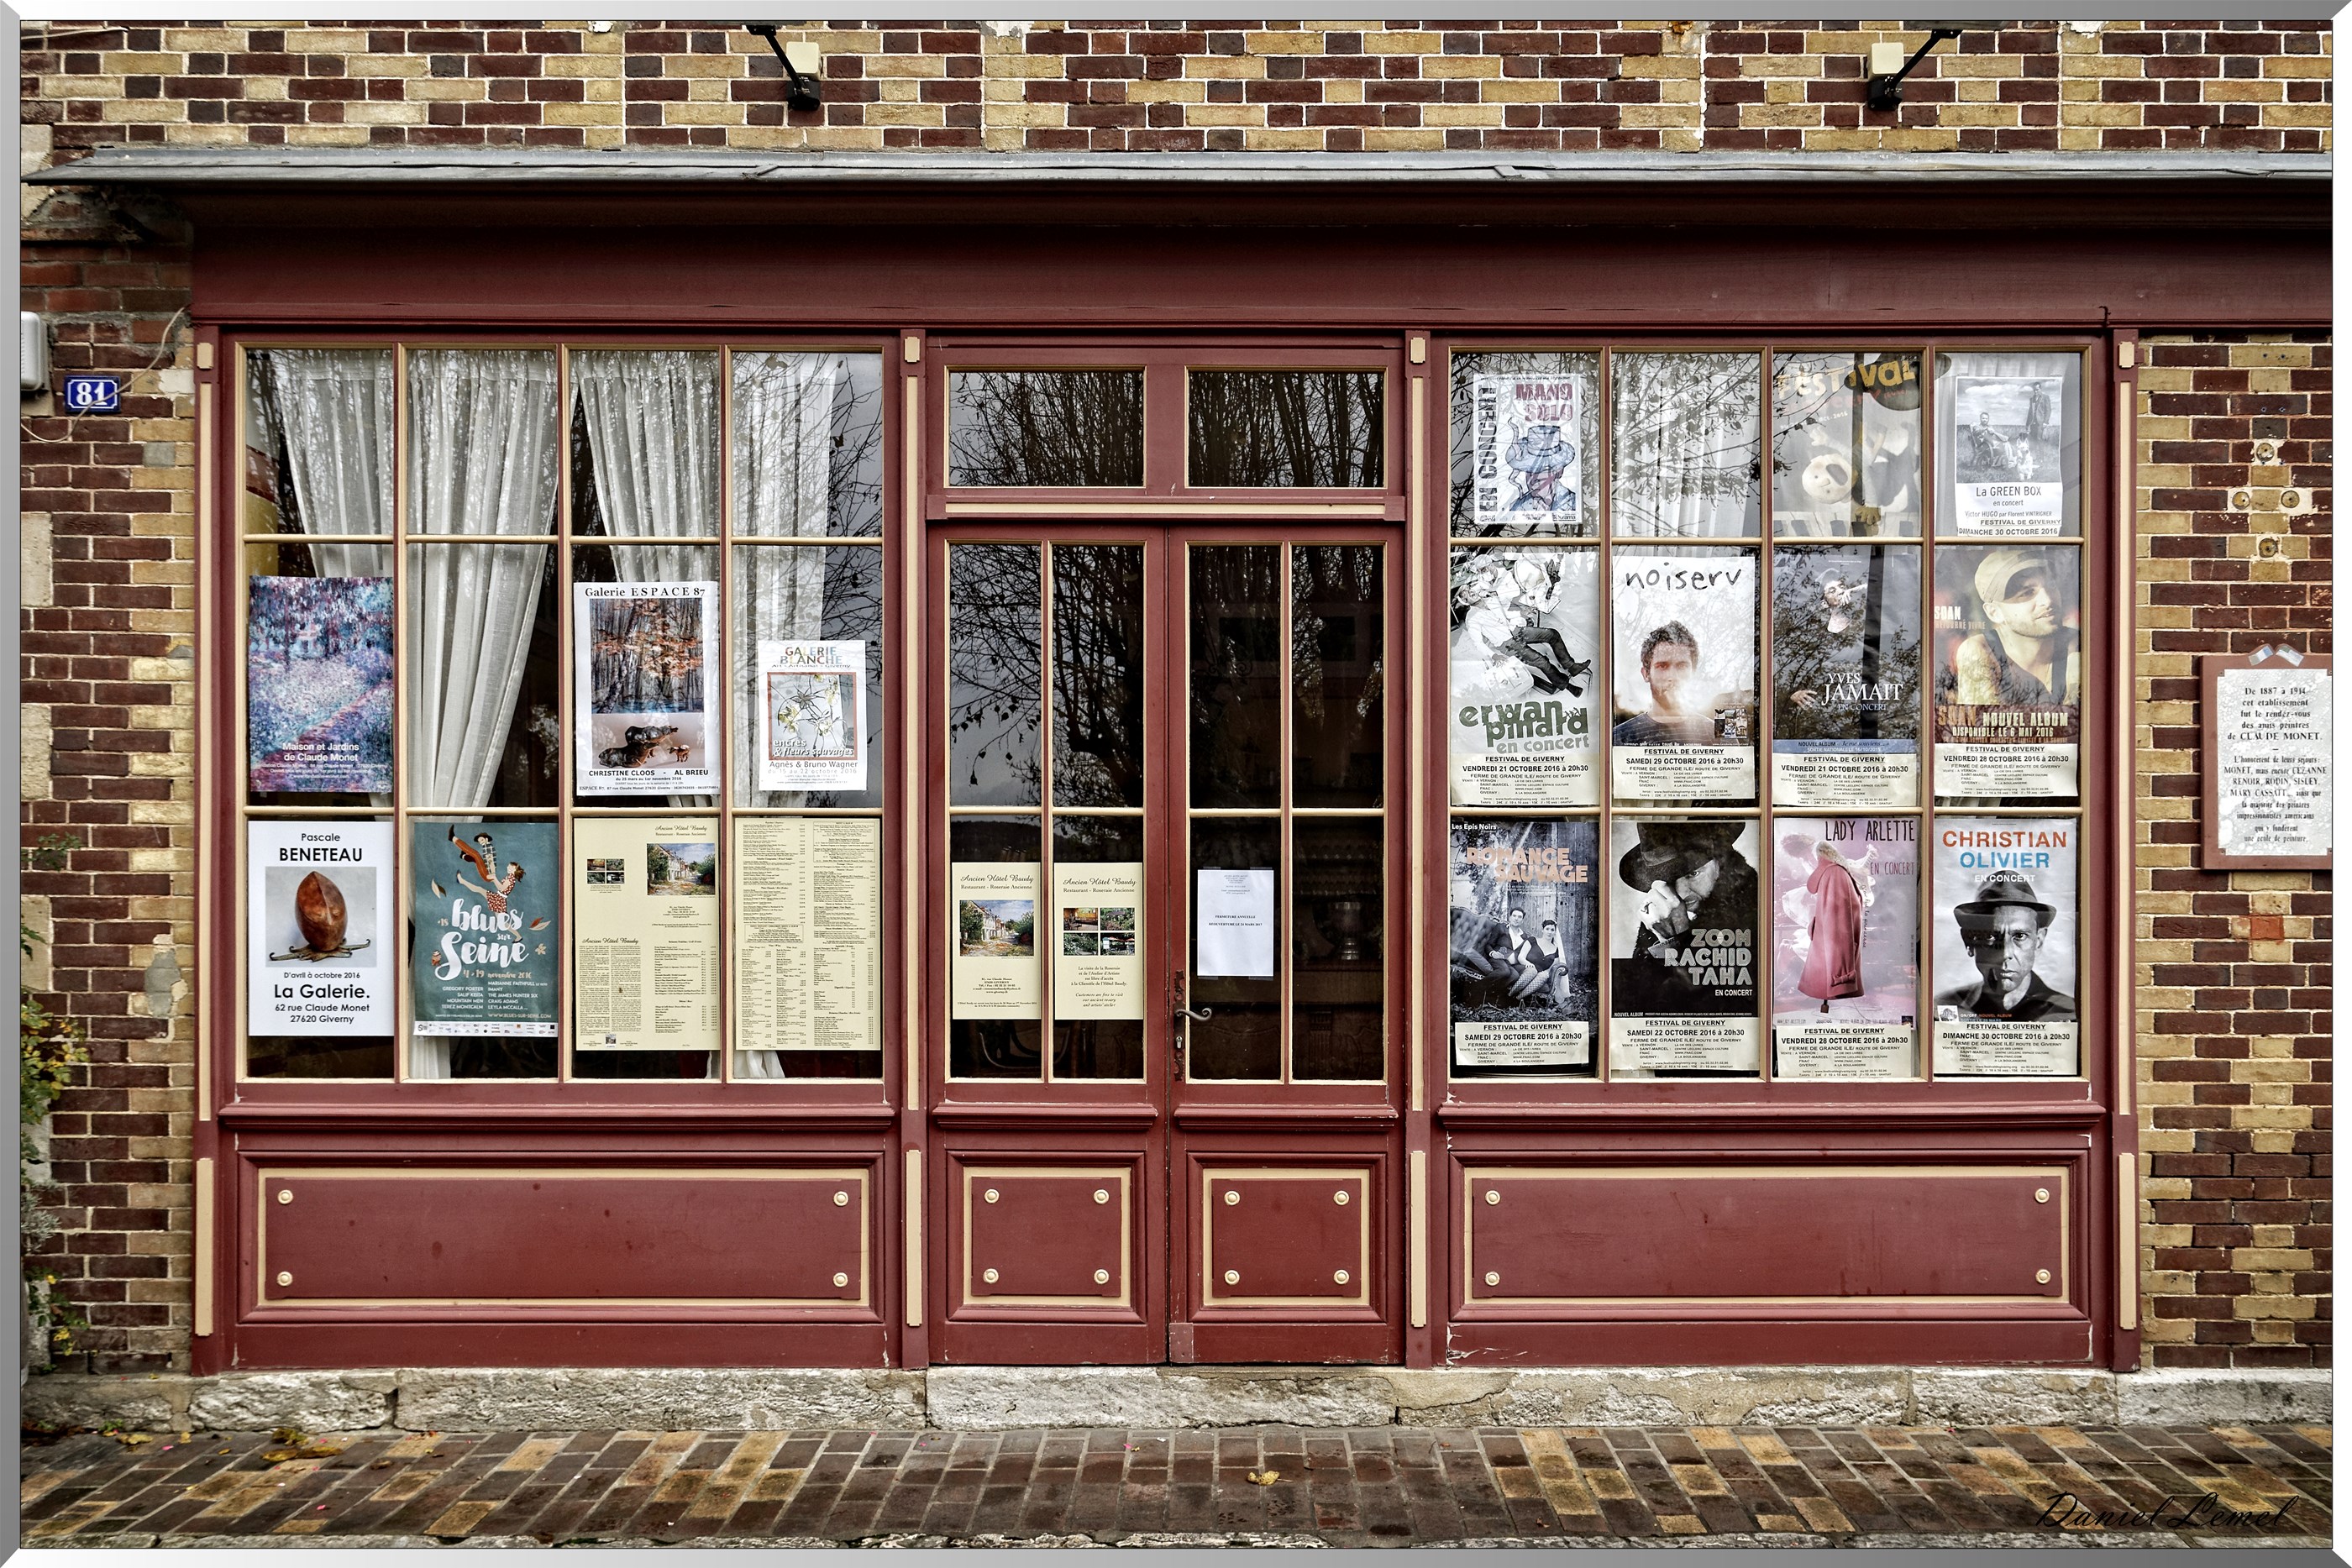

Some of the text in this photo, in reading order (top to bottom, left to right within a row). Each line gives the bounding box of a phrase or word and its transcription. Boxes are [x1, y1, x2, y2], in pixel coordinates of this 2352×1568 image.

[76, 382, 108, 405] 81
[1515, 383, 1572, 401] MANO
[1525, 404, 1572, 421] SOLO
[1478, 385, 1497, 480] CONCERT
[1977, 486, 2041, 496] La GREEN BOX
[1478, 488, 1498, 511] EN
[1625, 562, 1742, 590] noiserv
[585, 587, 705, 597] Galerie ESPACE 87
[1935, 606, 1961, 620] SOAN
[780, 655, 843, 664] BLANCHE
[785, 647, 837, 656] GALERIE
[1828, 674, 1861, 684] YVES
[1821, 684, 1903, 705] JAMAIT
[1459, 701, 1563, 727] erwan
[1938, 705, 2068, 726] SOAN NOUVEL ALBUM
[1952, 727, 2054, 737] DISPONIBLE LE 6 MAI 2016
[2280, 721, 2309, 730] peintres
[328, 742, 359, 751] Jardins
[774, 747, 854, 757] & fleurs sauvages
[1497, 735, 1589, 753] en concert
[302, 833, 340, 842] Pascale
[1825, 821, 1915, 842] LADY ARLETTE
[1942, 831, 2067, 848] CHRISTIAN
[280, 848, 362, 862] BENETEAU
[1467, 848, 1569, 866] ROMANCE
[1960, 852, 2050, 868] OLIVIER
[1494, 865, 1588, 883] SAUVAGE
[1870, 862, 1914, 876] EN CONCERT
[1010, 874, 1033, 884] Baudy
[1111, 878, 1137, 887] Baudy
[452, 899, 523, 933] blues
[1690, 929, 1751, 947] ZOOM
[434, 931, 529, 981] Seine
[1664, 948, 1751, 967] RACHID
[1688, 968, 1752, 986] TAHA
[275, 983, 370, 999] La Galerie.
[305, 1004, 339, 1012] Claude
[319, 1015, 354, 1024] Giverny
